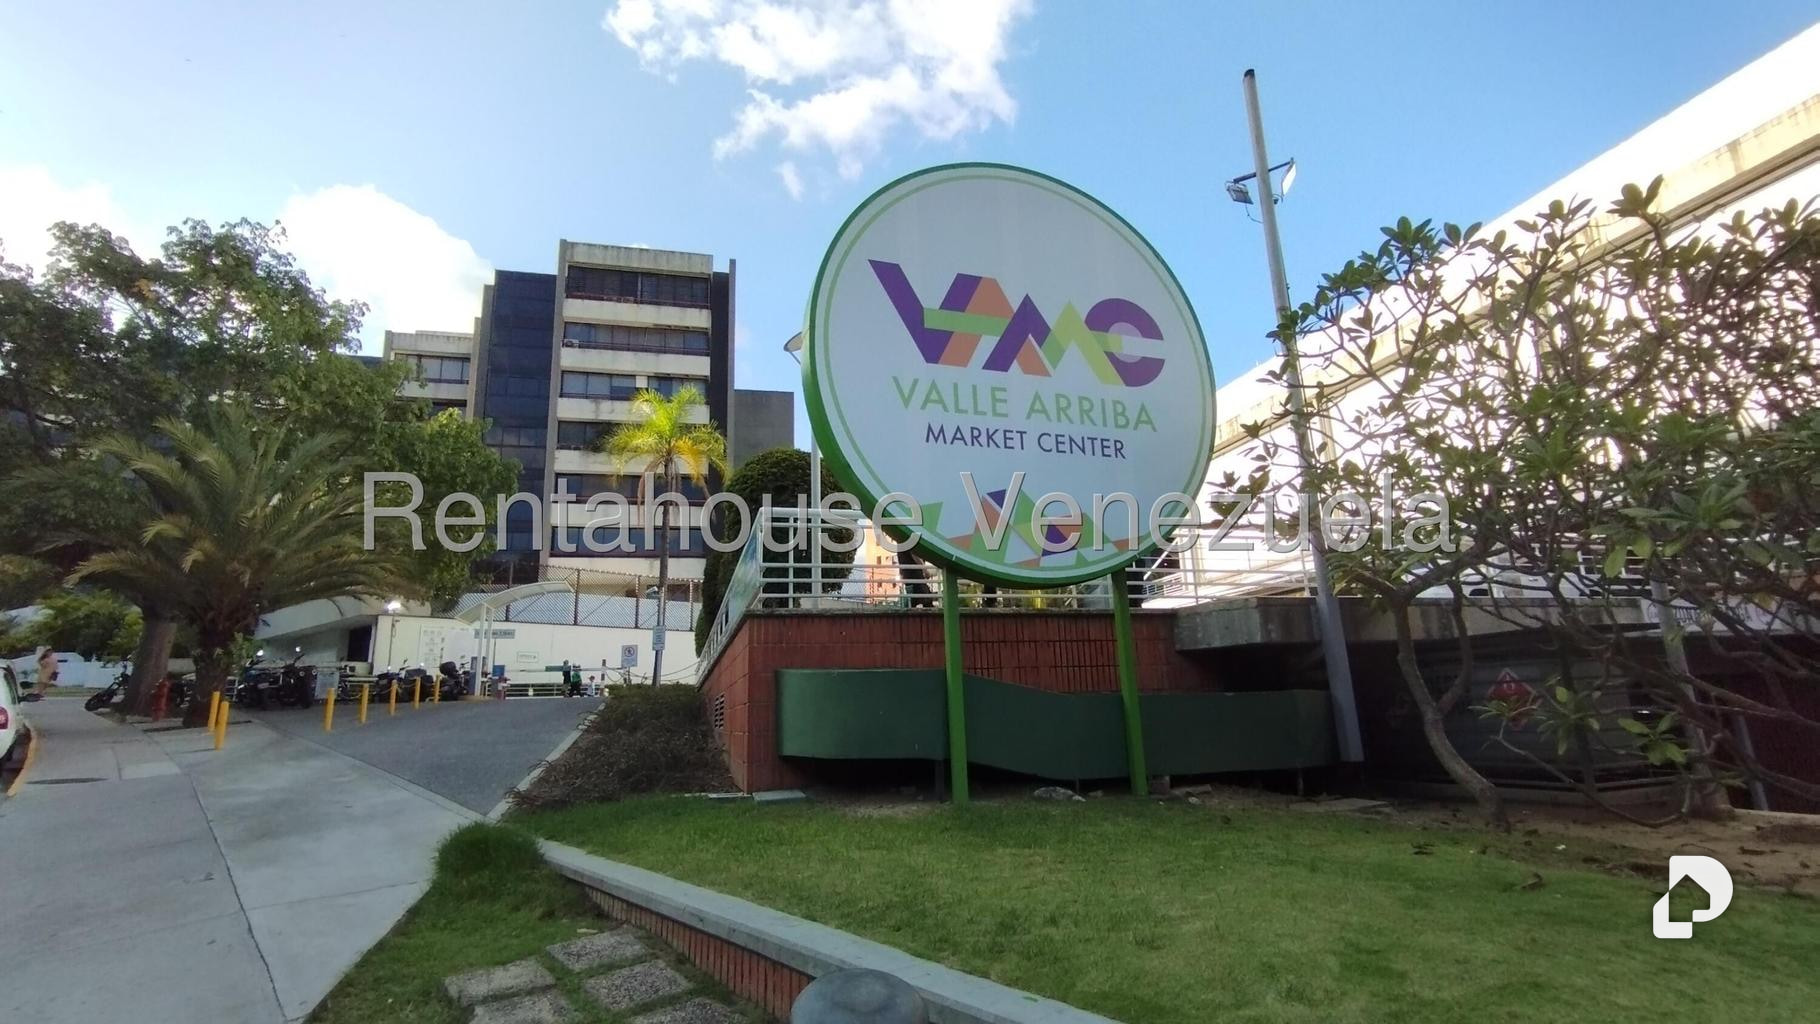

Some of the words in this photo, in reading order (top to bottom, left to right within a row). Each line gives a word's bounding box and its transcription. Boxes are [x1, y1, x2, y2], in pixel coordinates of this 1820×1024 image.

[892, 375, 1009, 418] VALLE
[1025, 390, 1158, 432] ARRIBA
[924, 422, 1028, 451] MARKET
[1037, 432, 1127, 460] CENTER
